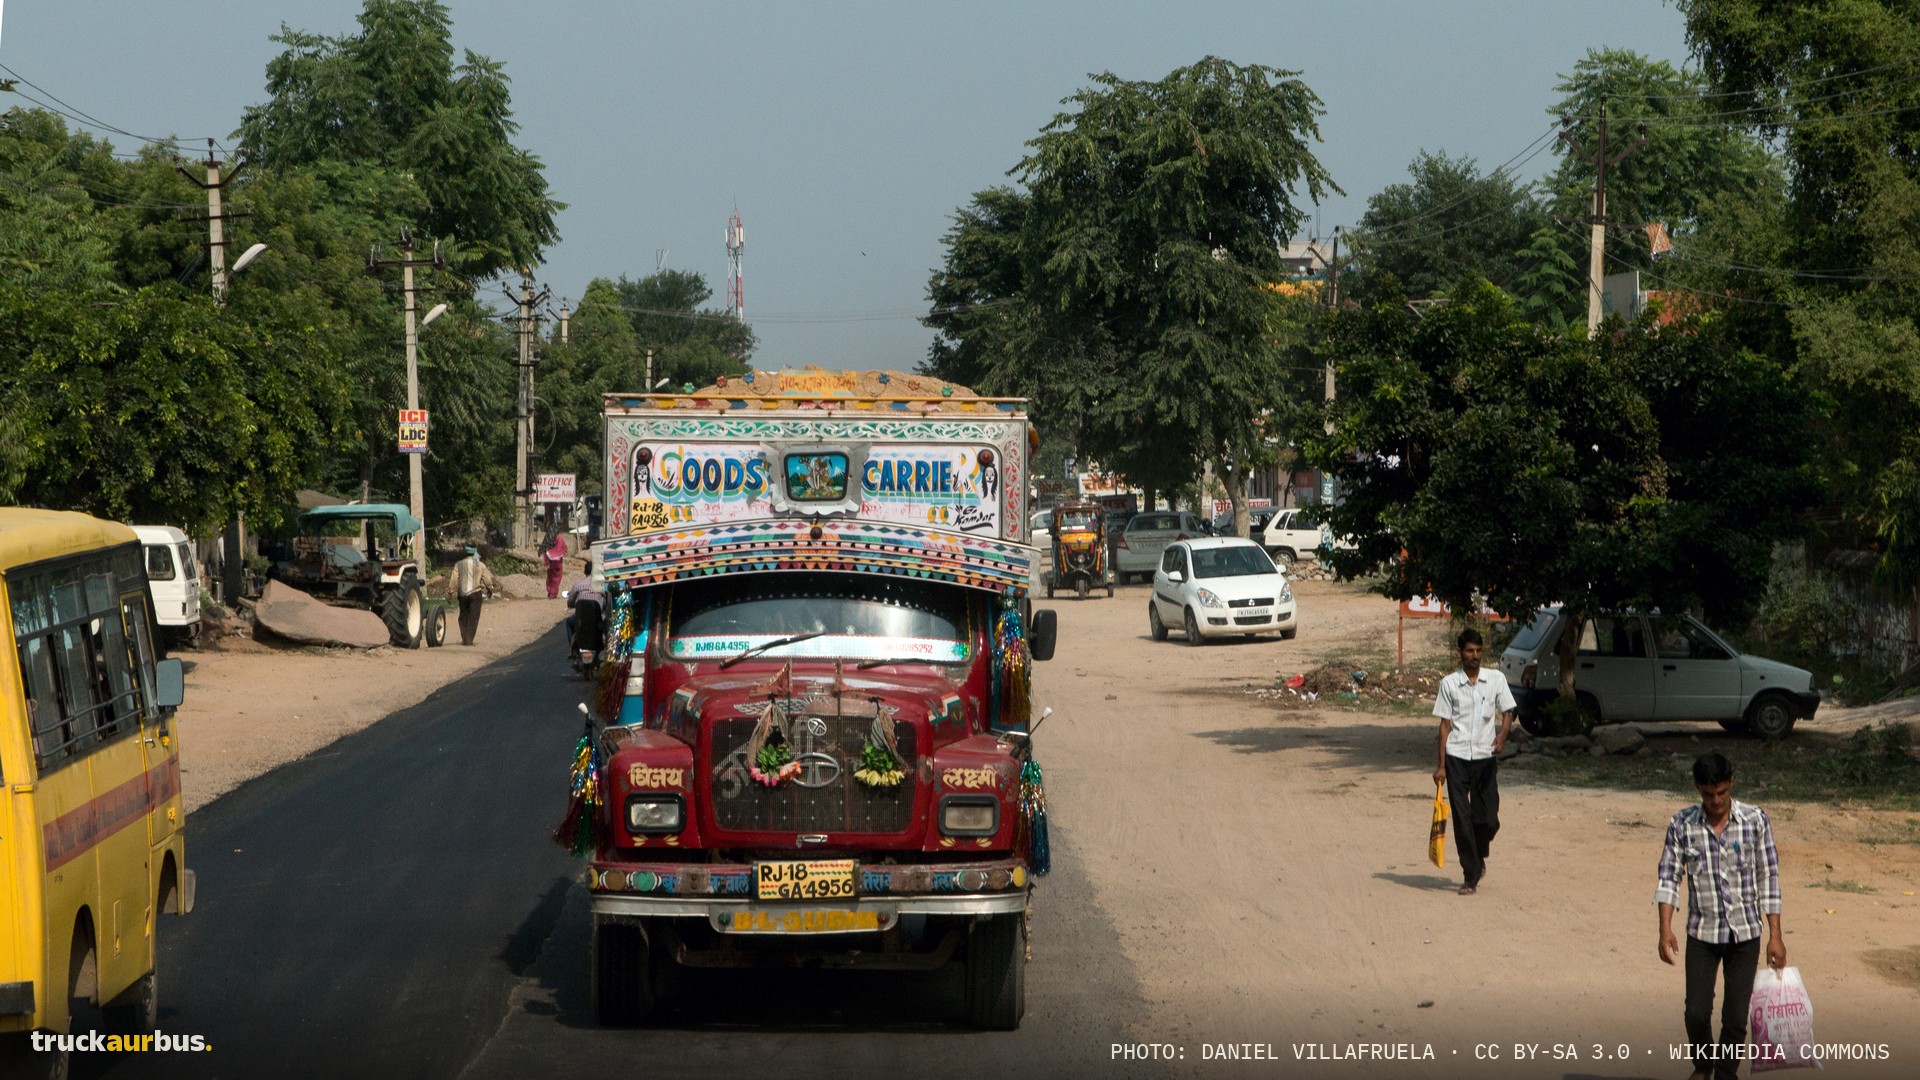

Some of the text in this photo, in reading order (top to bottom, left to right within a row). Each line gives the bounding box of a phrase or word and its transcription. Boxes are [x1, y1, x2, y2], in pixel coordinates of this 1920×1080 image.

[400, 411, 426, 423] ICI
[400, 429, 426, 441] LDC
[652, 445, 981, 499] GOODS CARRIER
[627, 762, 685, 789] विजय
[760, 863, 808, 882] RJ-18
[778, 878, 853, 899] GA-4956
